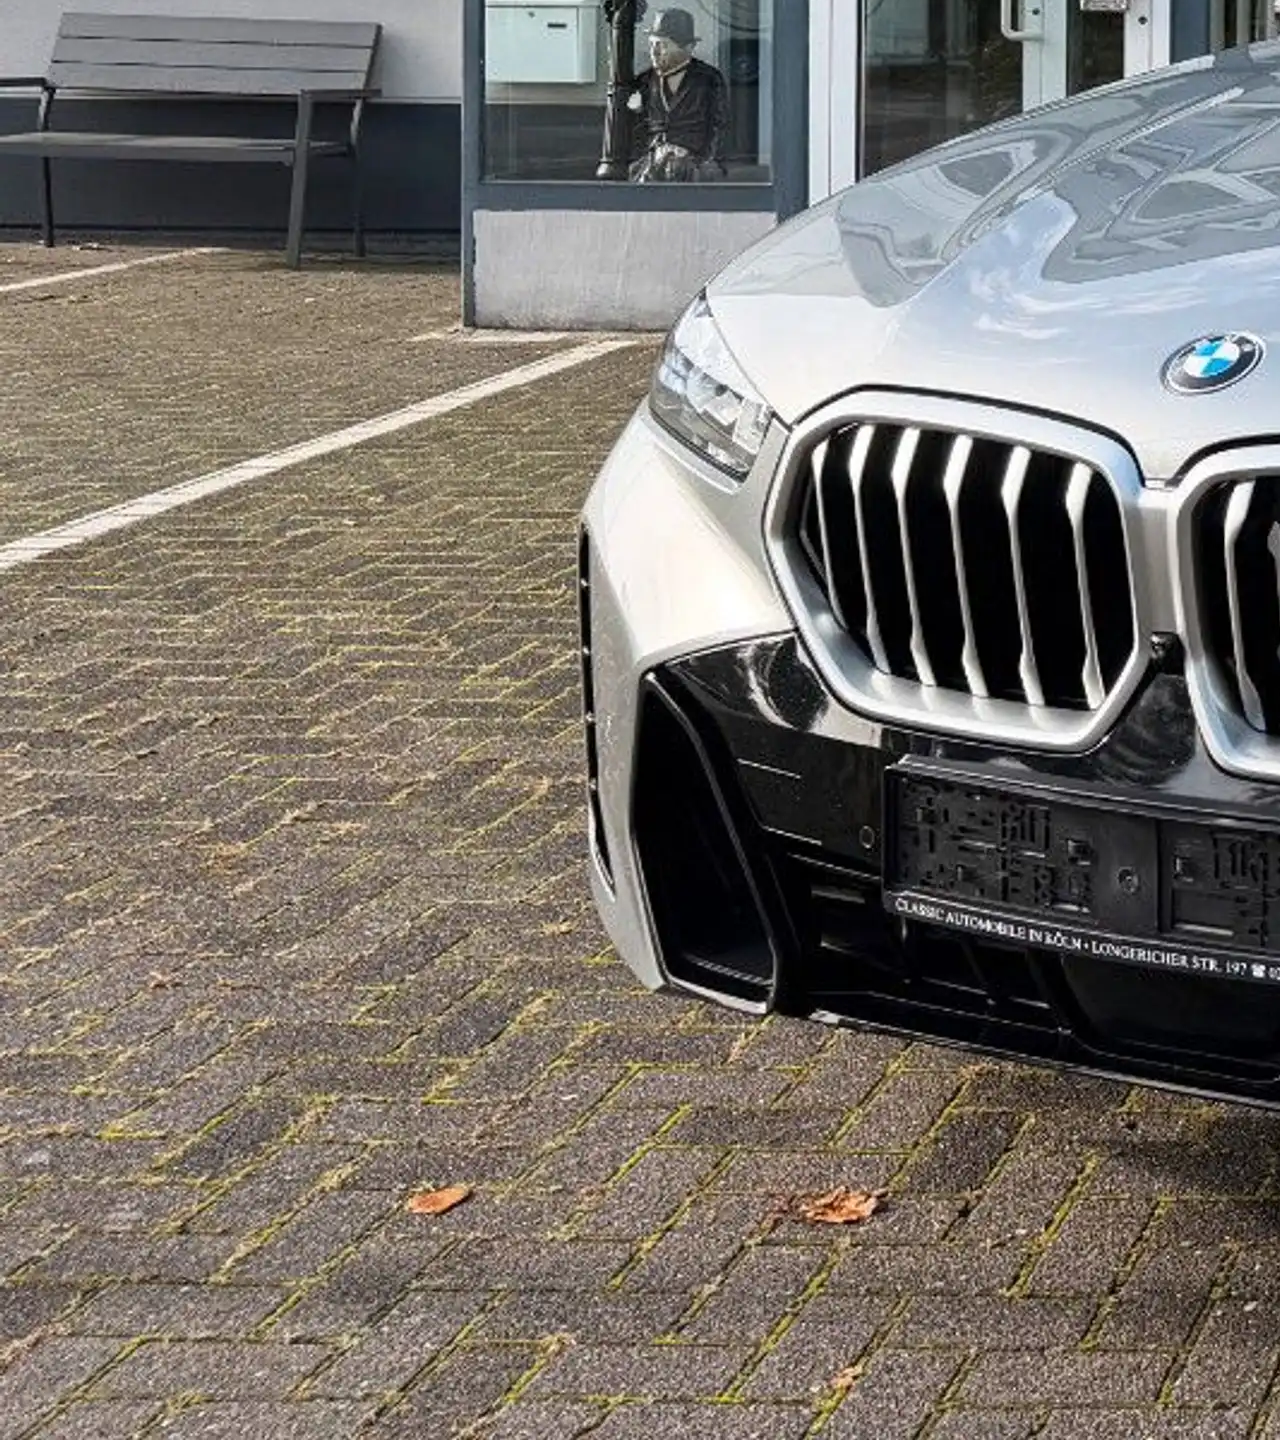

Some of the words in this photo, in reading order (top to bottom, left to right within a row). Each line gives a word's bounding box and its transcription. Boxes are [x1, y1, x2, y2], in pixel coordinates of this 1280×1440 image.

[895, 897, 945, 921] CLASSIC
[946, 912, 1027, 940] AUTOMOBILE
[1029, 929, 1043, 943] IN
[1044, 931, 1082, 950] KÖLN
[1091, 940, 1189, 968] LONGERICHER
